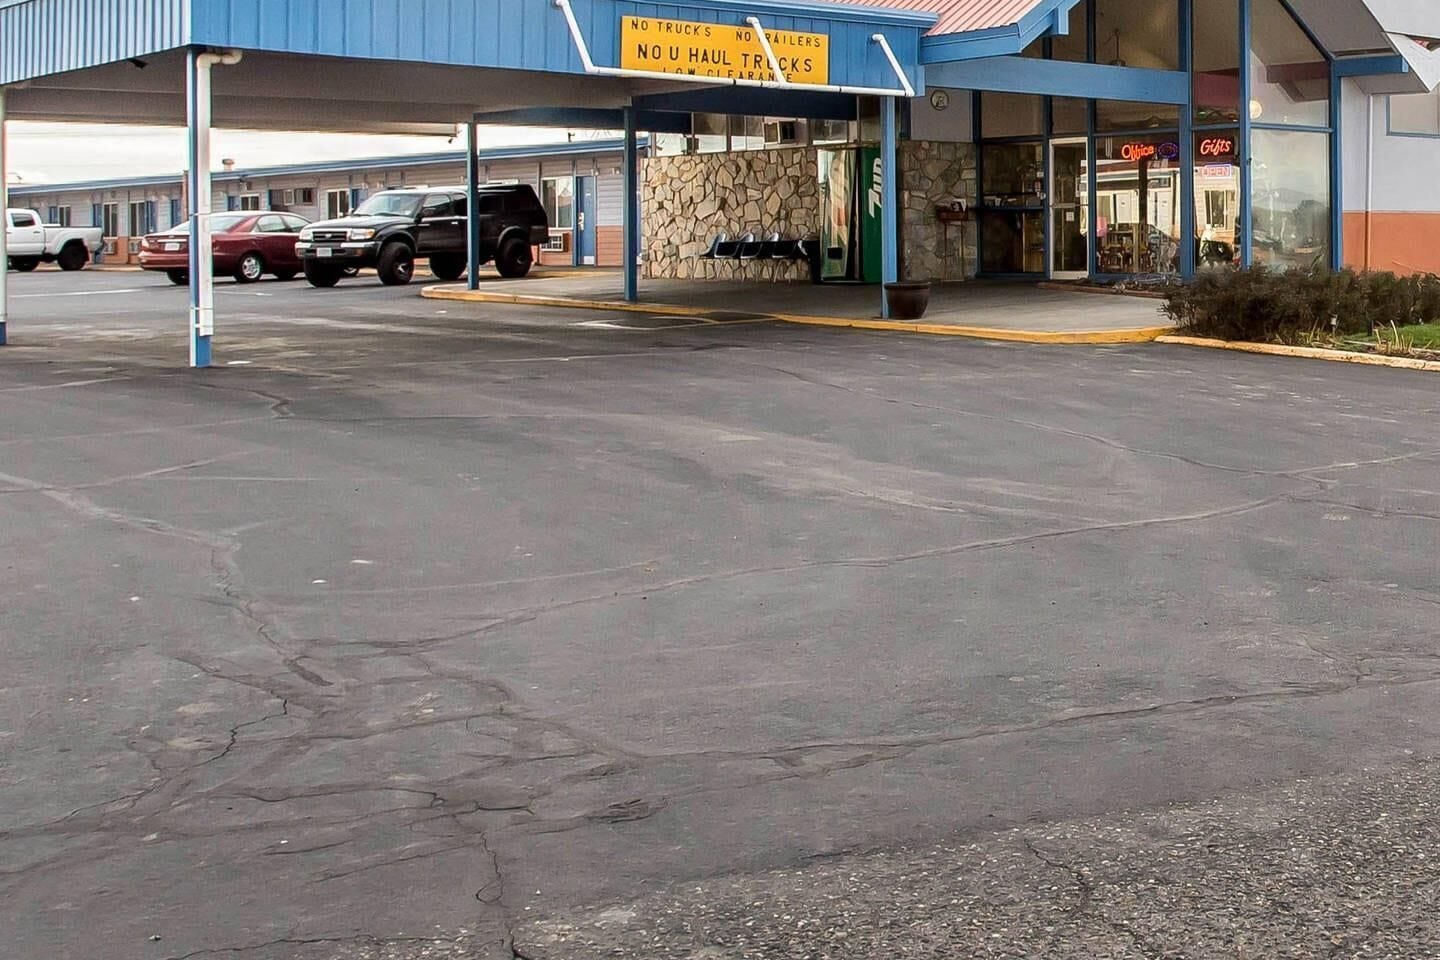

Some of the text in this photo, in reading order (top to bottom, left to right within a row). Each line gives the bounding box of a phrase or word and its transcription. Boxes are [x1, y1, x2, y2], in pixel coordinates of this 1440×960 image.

[631, 18, 712, 37] NO TRUCKS
[736, 31, 821, 48] NO RAILERS
[638, 43, 661, 60] NO
[669, 46, 679, 61] U
[689, 47, 731, 66] HAUL
[706, 69, 793, 83] CEARANE
[1121, 143, 1155, 161] Office
[1200, 138, 1232, 156] Gifts
[1201, 166, 1230, 177] OPEN
